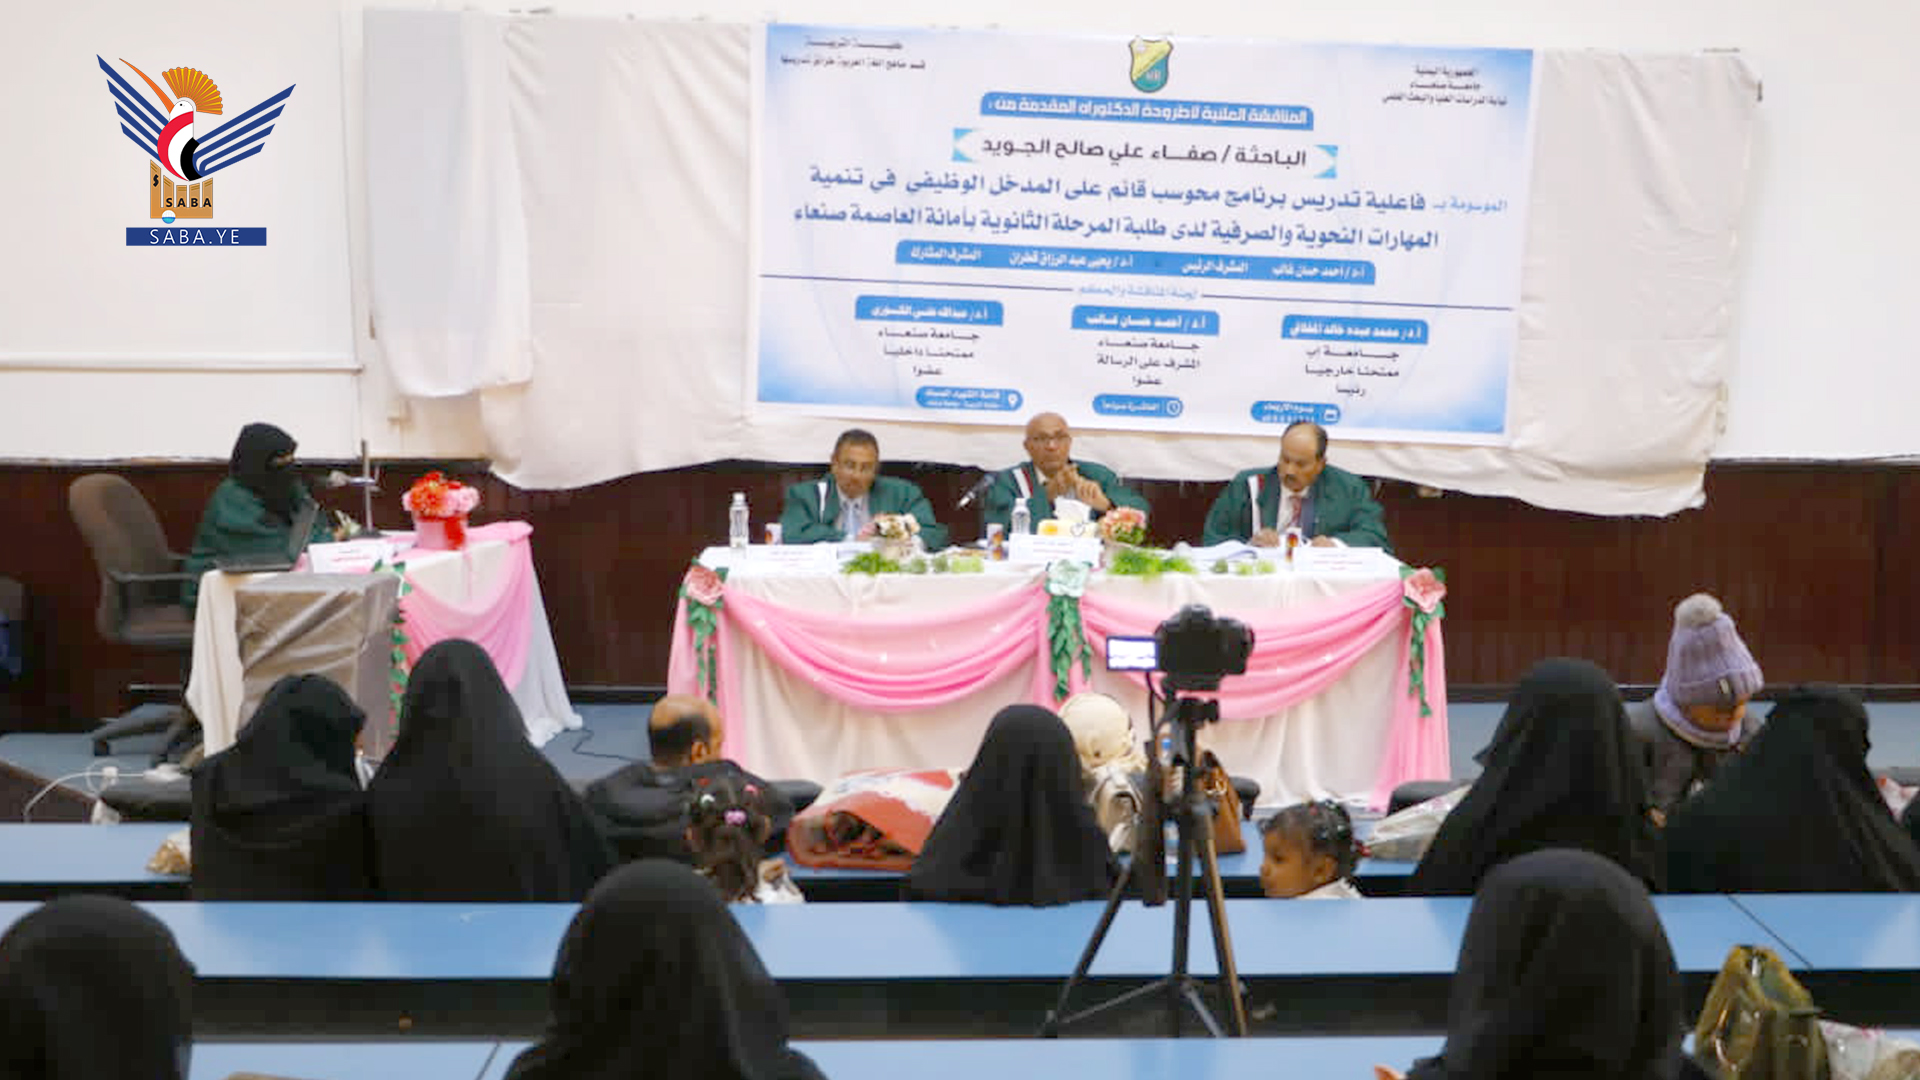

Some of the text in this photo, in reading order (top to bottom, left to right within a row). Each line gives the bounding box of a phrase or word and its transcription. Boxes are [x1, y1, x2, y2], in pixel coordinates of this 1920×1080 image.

[1018, 97, 1077, 114] المقدمة
[1079, 100, 1139, 117] الدكتوراه
[1248, 107, 1308, 125] المناقشة
[983, 138, 1051, 158] الجويد
[1055, 138, 1105, 159] صالح
[1109, 142, 1144, 166] علي
[1234, 145, 1307, 170] الباحثة
[809, 165, 864, 189] تنمية
[989, 174, 1060, 198] المدخل
[1063, 180, 1103, 200] على
[1151, 188, 1220, 205] محوسب
[1224, 185, 1286, 209] برنامج
[1291, 190, 1362, 212] تدريس
[1365, 190, 1426, 213] فاعلية
[794, 202, 848, 221] صنعاء
[850, 202, 922, 225] العاصمة
[981, 209, 1049, 235] الثانوية
[1051, 213, 1120, 237] المرحلة
[1123, 215, 1167, 241] طلبة
[1210, 219, 1293, 247] والصرفية
[1296, 223, 1363, 249] النحوية
[1366, 227, 1439, 252] المهارات
